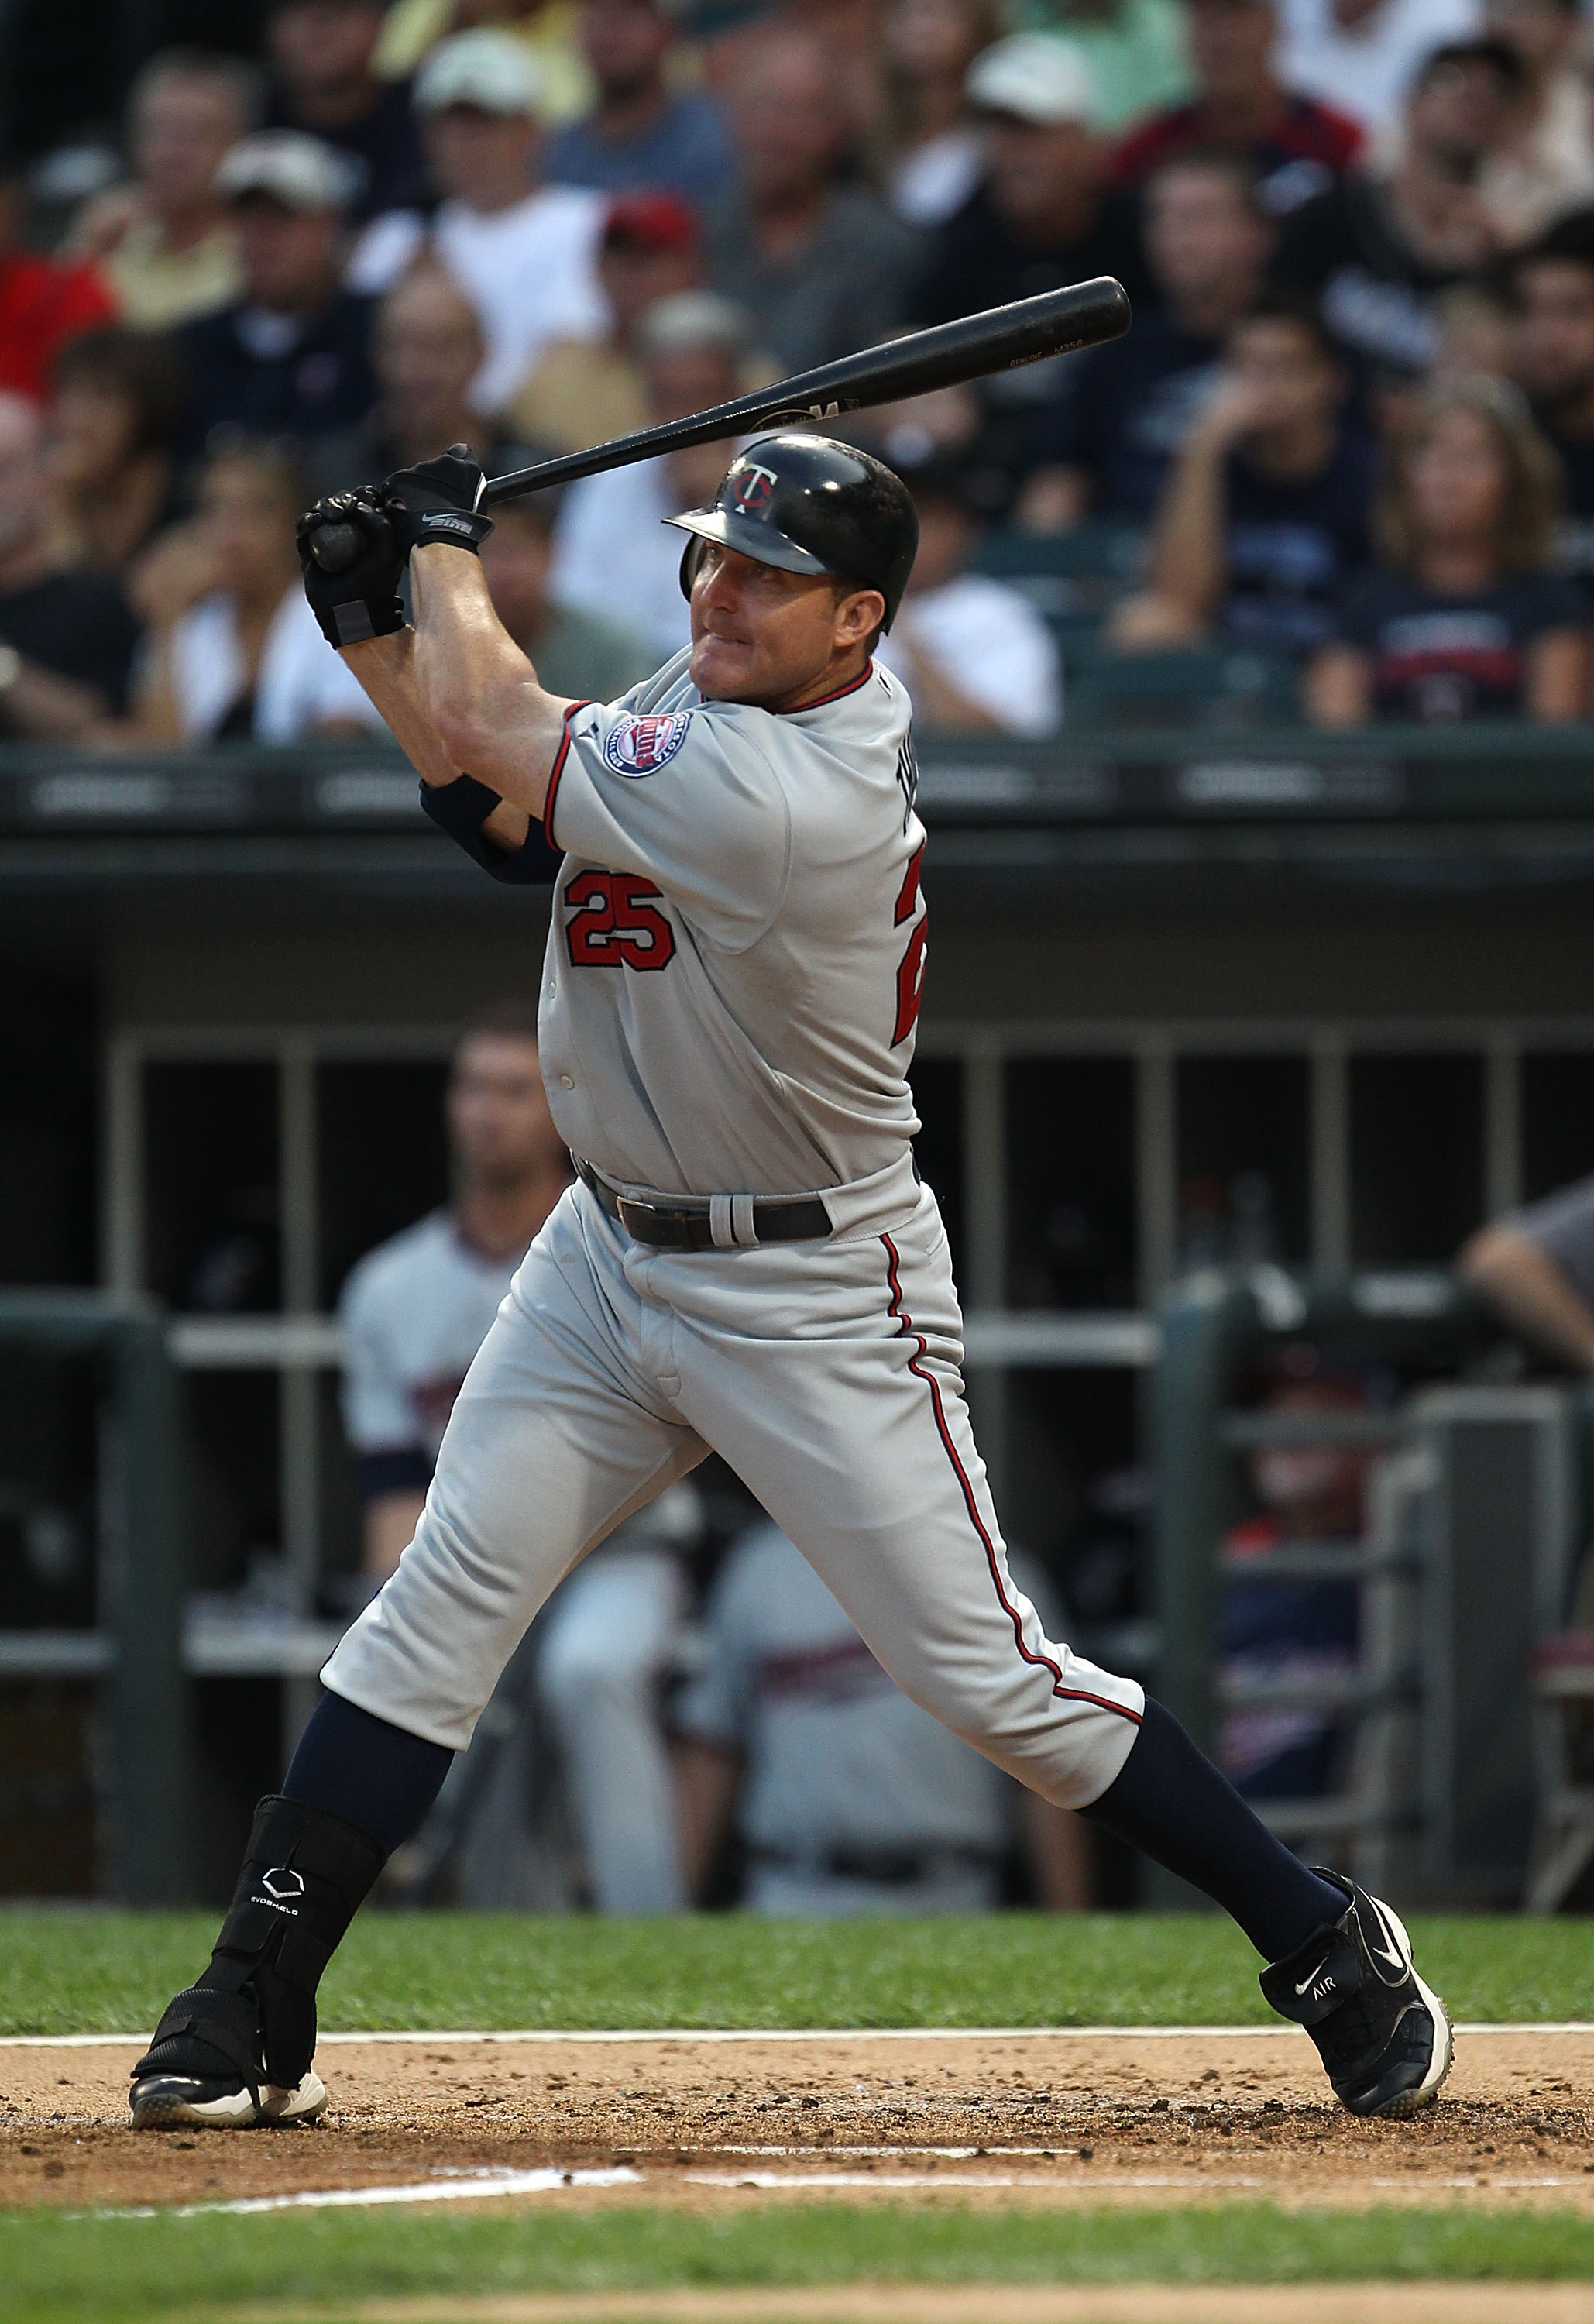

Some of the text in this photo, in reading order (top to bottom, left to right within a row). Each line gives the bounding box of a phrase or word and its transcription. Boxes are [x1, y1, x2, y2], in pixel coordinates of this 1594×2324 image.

[564, 869, 676, 972] 25
[250, 1896, 299, 1916] EVOSHIELD
[1313, 1976, 1337, 2002] AIR
